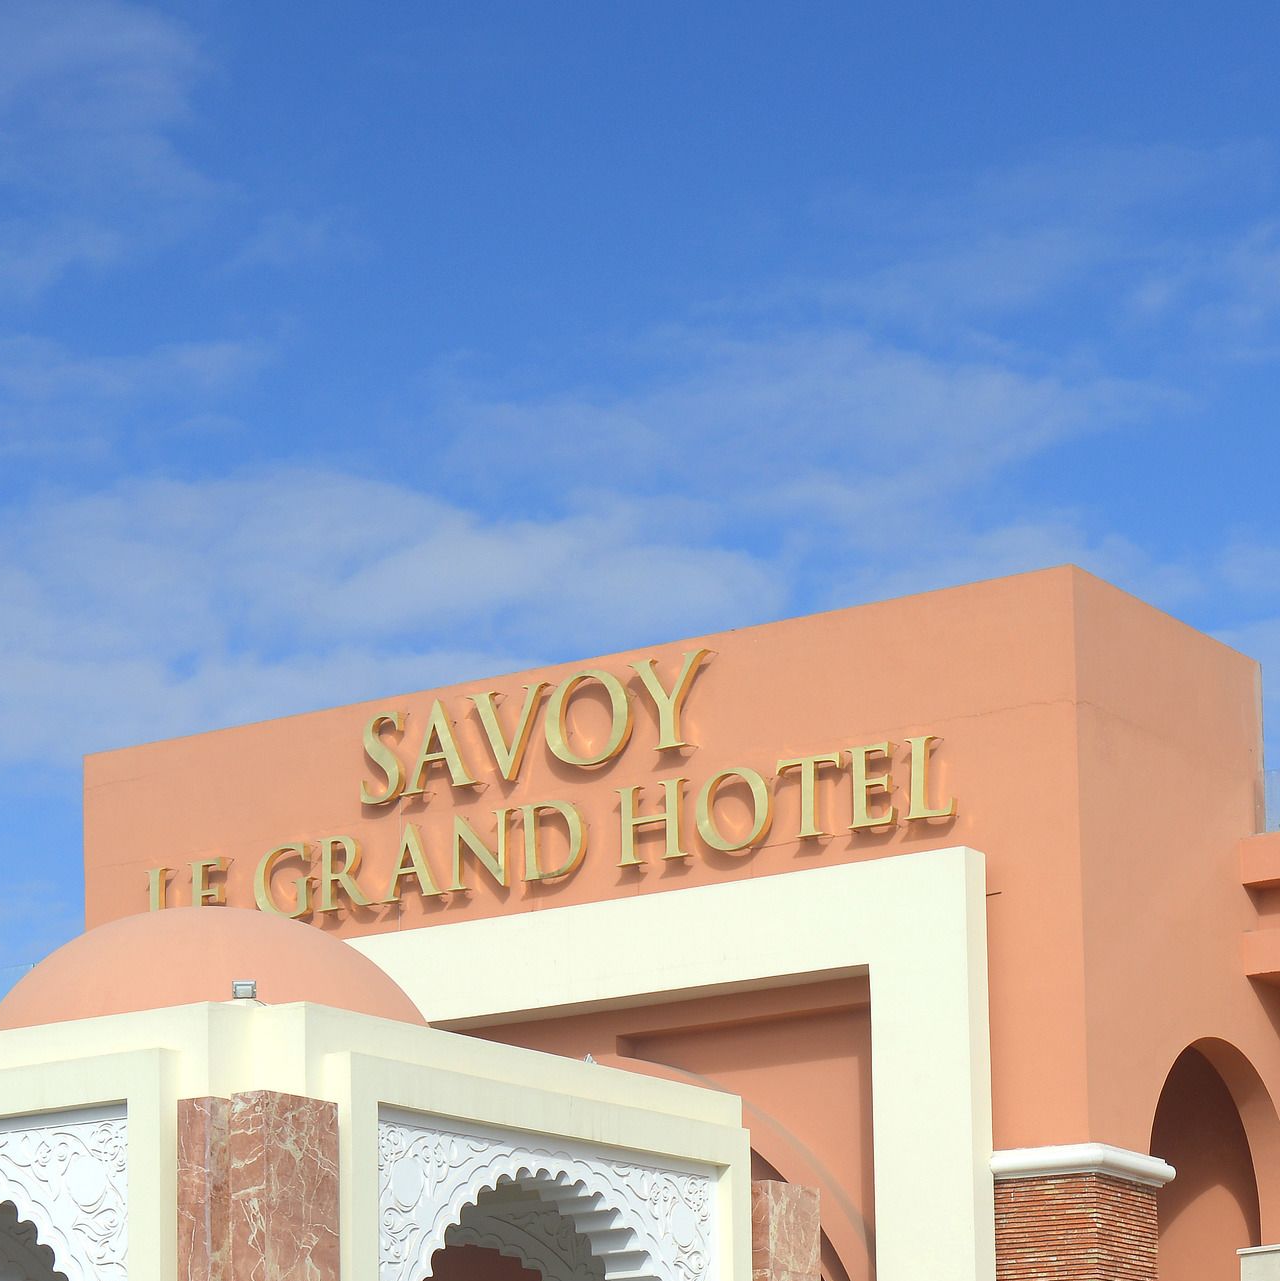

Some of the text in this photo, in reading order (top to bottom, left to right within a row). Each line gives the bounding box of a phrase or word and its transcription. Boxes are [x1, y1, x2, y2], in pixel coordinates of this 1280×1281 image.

[360, 648, 716, 805] SAVOY
[253, 800, 588, 920] GRAND
[616, 735, 959, 868] HOTEL
